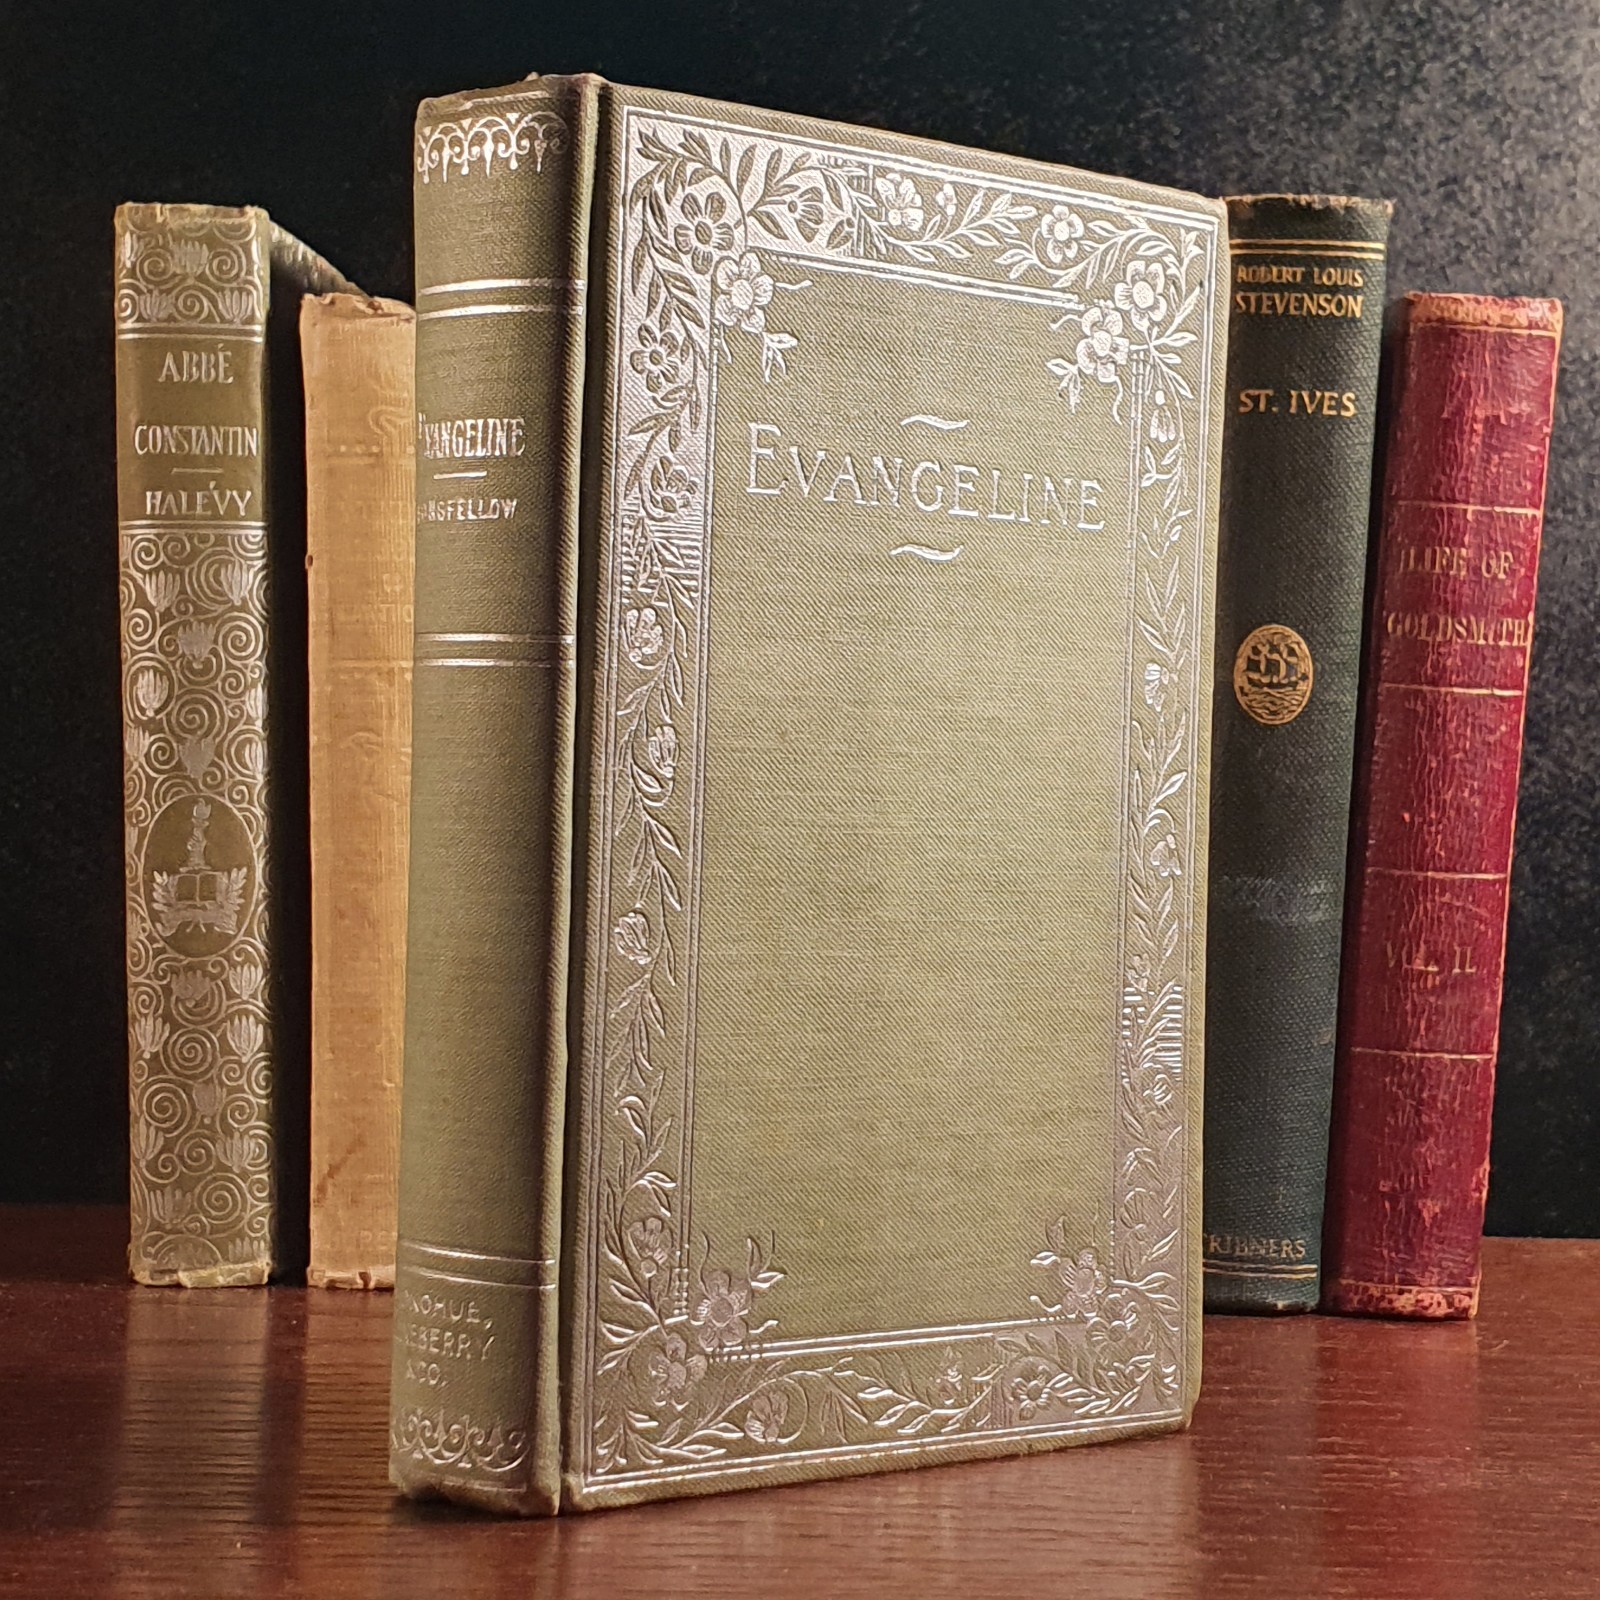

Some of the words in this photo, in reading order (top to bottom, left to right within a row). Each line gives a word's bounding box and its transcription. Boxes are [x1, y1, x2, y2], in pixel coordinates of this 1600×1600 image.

[1313, 267, 1364, 287] LOUIS
[1235, 291, 1364, 318] STEVENSON
[158, 344, 234, 383] ABBÉ
[1238, 389, 1279, 413] ST.
[1290, 390, 1357, 417] IVES
[135, 425, 258, 456] CONSTANTIN
